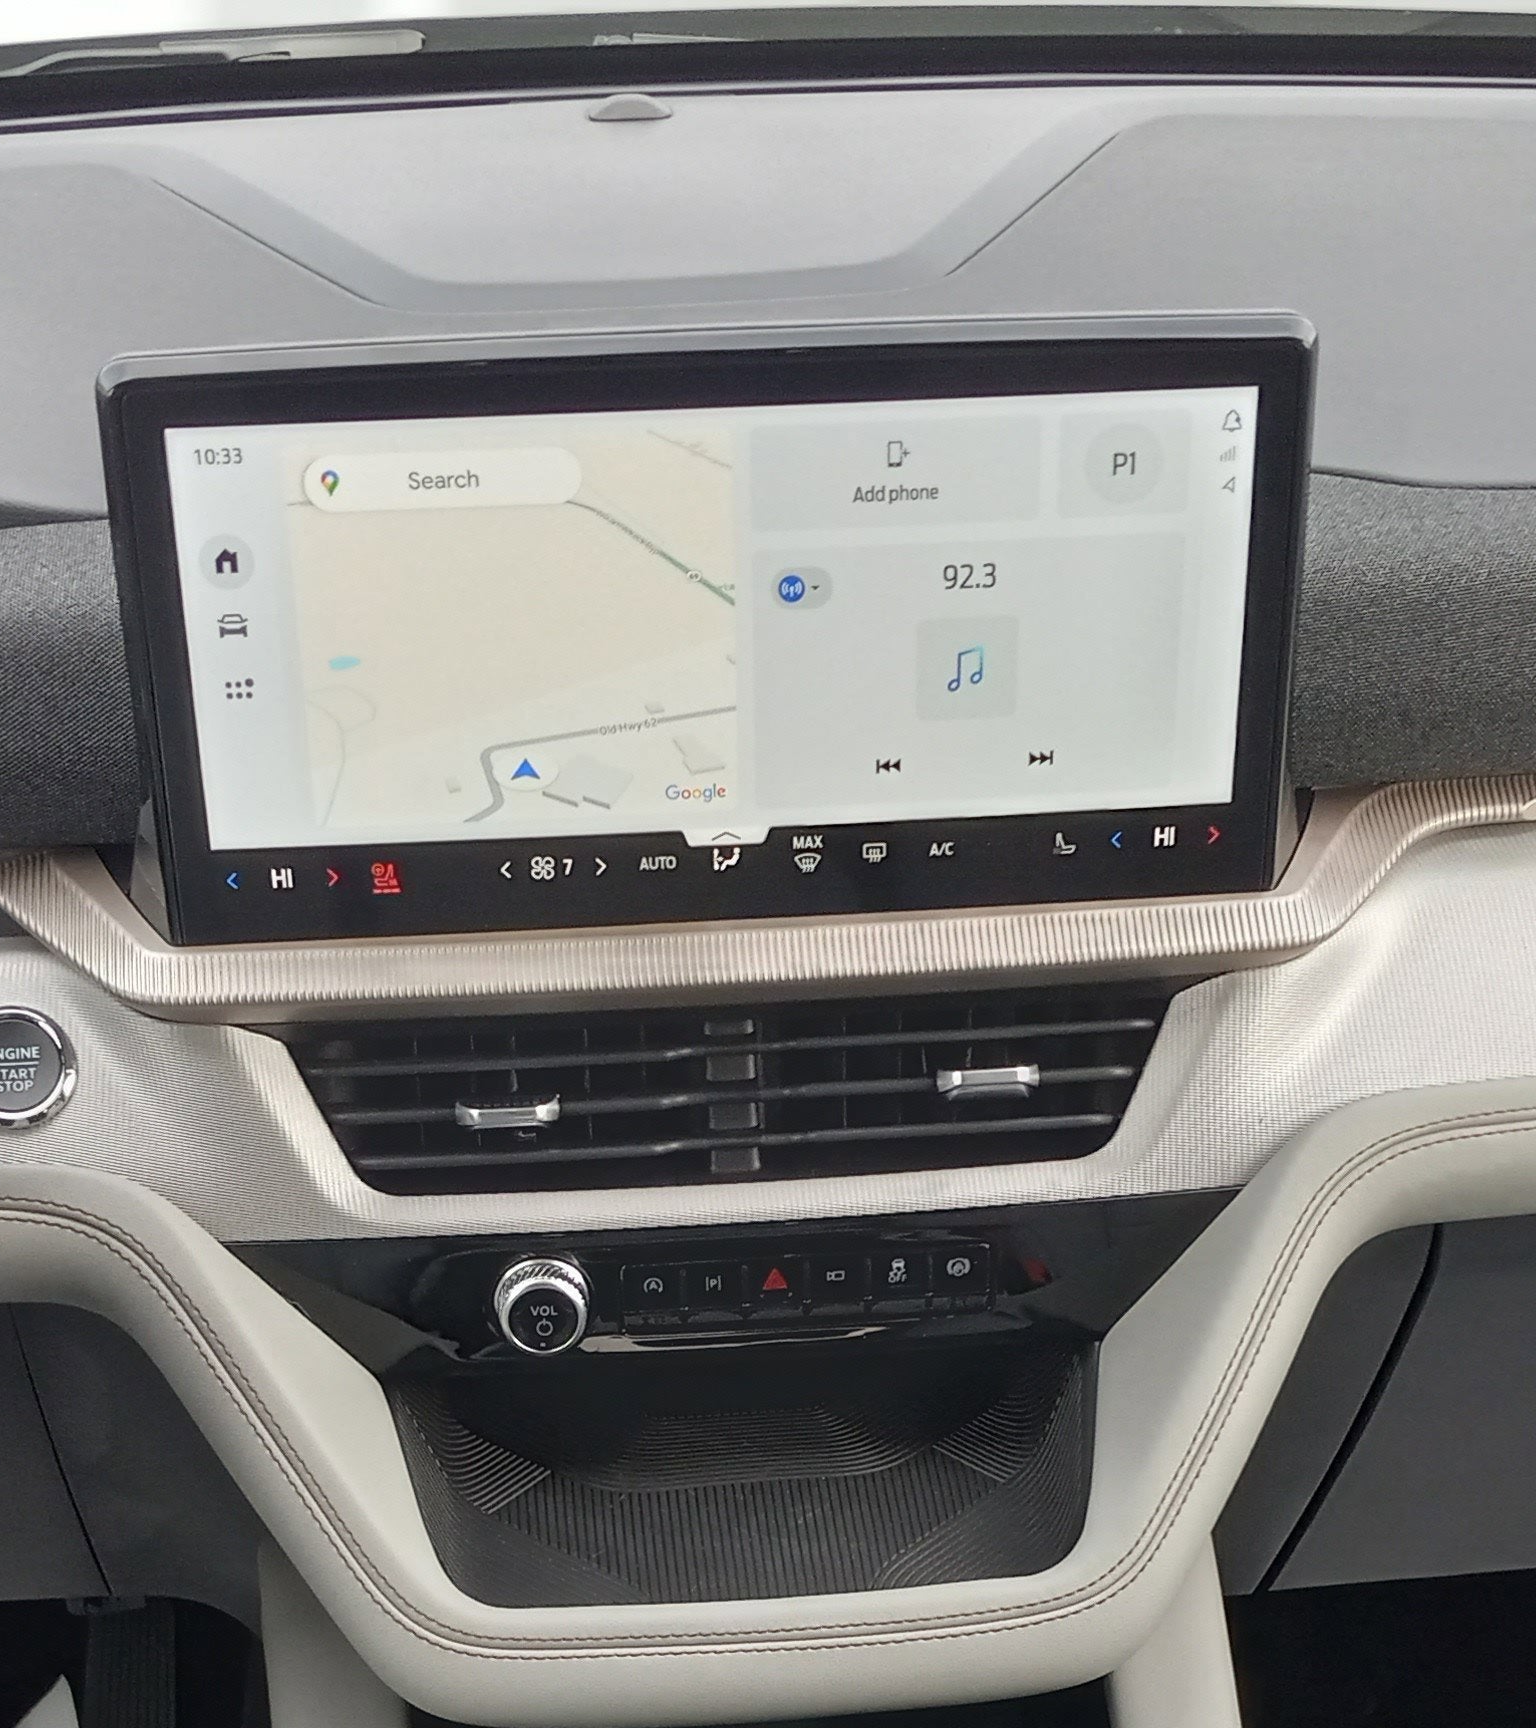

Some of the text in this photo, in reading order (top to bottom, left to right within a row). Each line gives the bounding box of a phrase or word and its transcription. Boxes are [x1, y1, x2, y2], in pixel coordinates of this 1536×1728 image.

[194, 448, 243, 466] 10:33
[1113, 451, 1136, 476] P1
[408, 470, 480, 491] Search
[852, 484, 939, 505] Add phone
[943, 563, 997, 589] 92.3
[665, 783, 726, 803] Google
[792, 835, 824, 850] MAX
[1153, 826, 1176, 848] HI
[929, 842, 955, 857] A/C
[562, 857, 573, 876] 7
[639, 856, 677, 871] AUTO
[270, 867, 294, 889] HI
[530, 1305, 558, 1317] VOL
